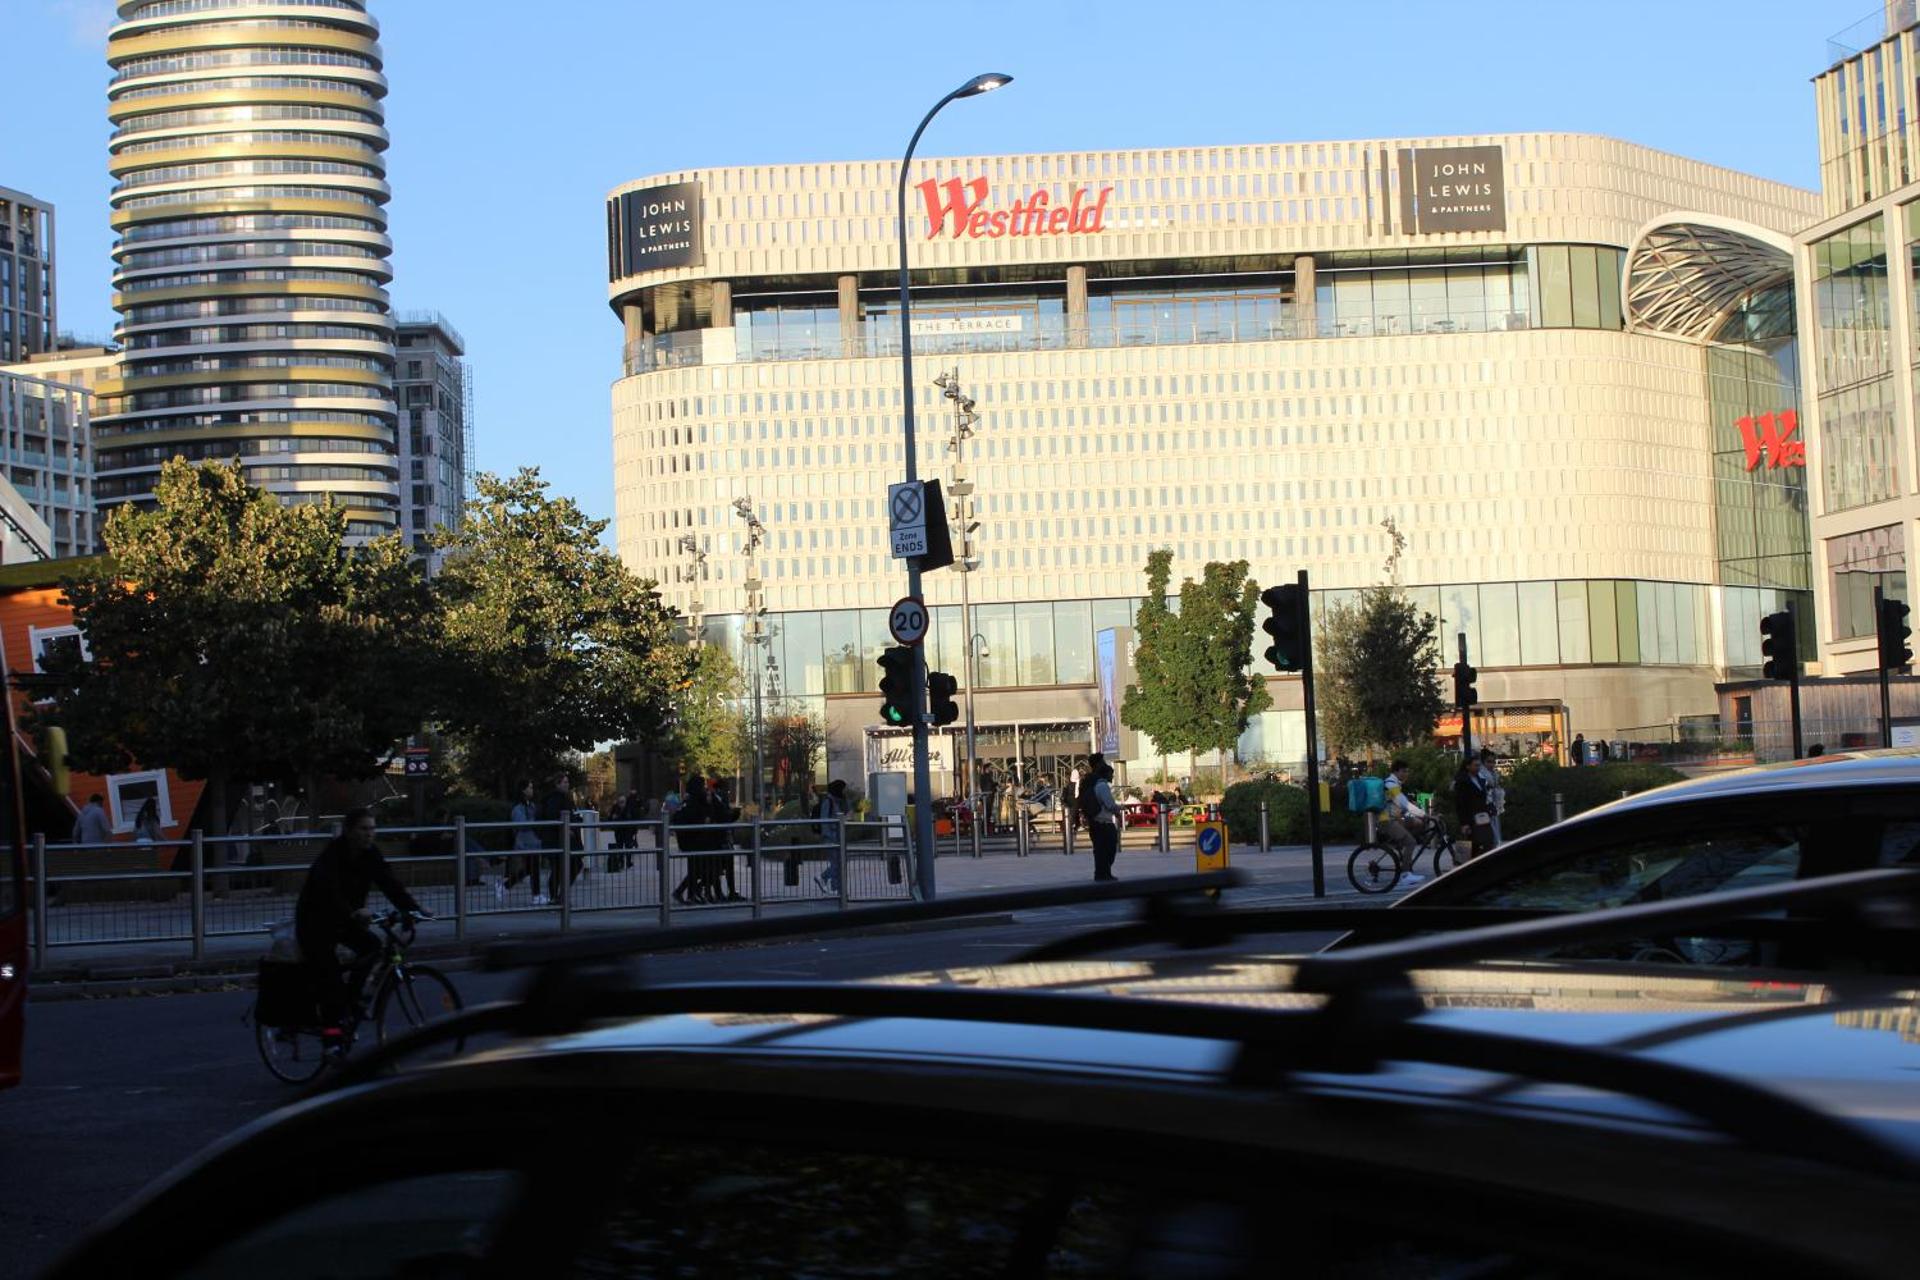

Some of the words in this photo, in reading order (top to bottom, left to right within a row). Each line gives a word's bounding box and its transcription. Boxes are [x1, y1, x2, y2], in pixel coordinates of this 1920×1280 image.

[1434, 163, 1486, 178] JOHN
[1429, 183, 1492, 198] LEWIS
[642, 199, 686, 219] JOHN
[914, 176, 1114, 240] Westfield
[1431, 206, 1438, 214] &
[1440, 204, 1491, 214] PARTNERS
[639, 220, 691, 238] LEWIS
[648, 241, 690, 254] PARTNERS
[916, 322, 943, 332] THE
[951, 319, 1011, 332] TERRACE
[899, 532, 918, 542] Zone
[895, 540, 924, 554] ENDS
[895, 610, 923, 632] 20
[880, 747, 909, 765] All
